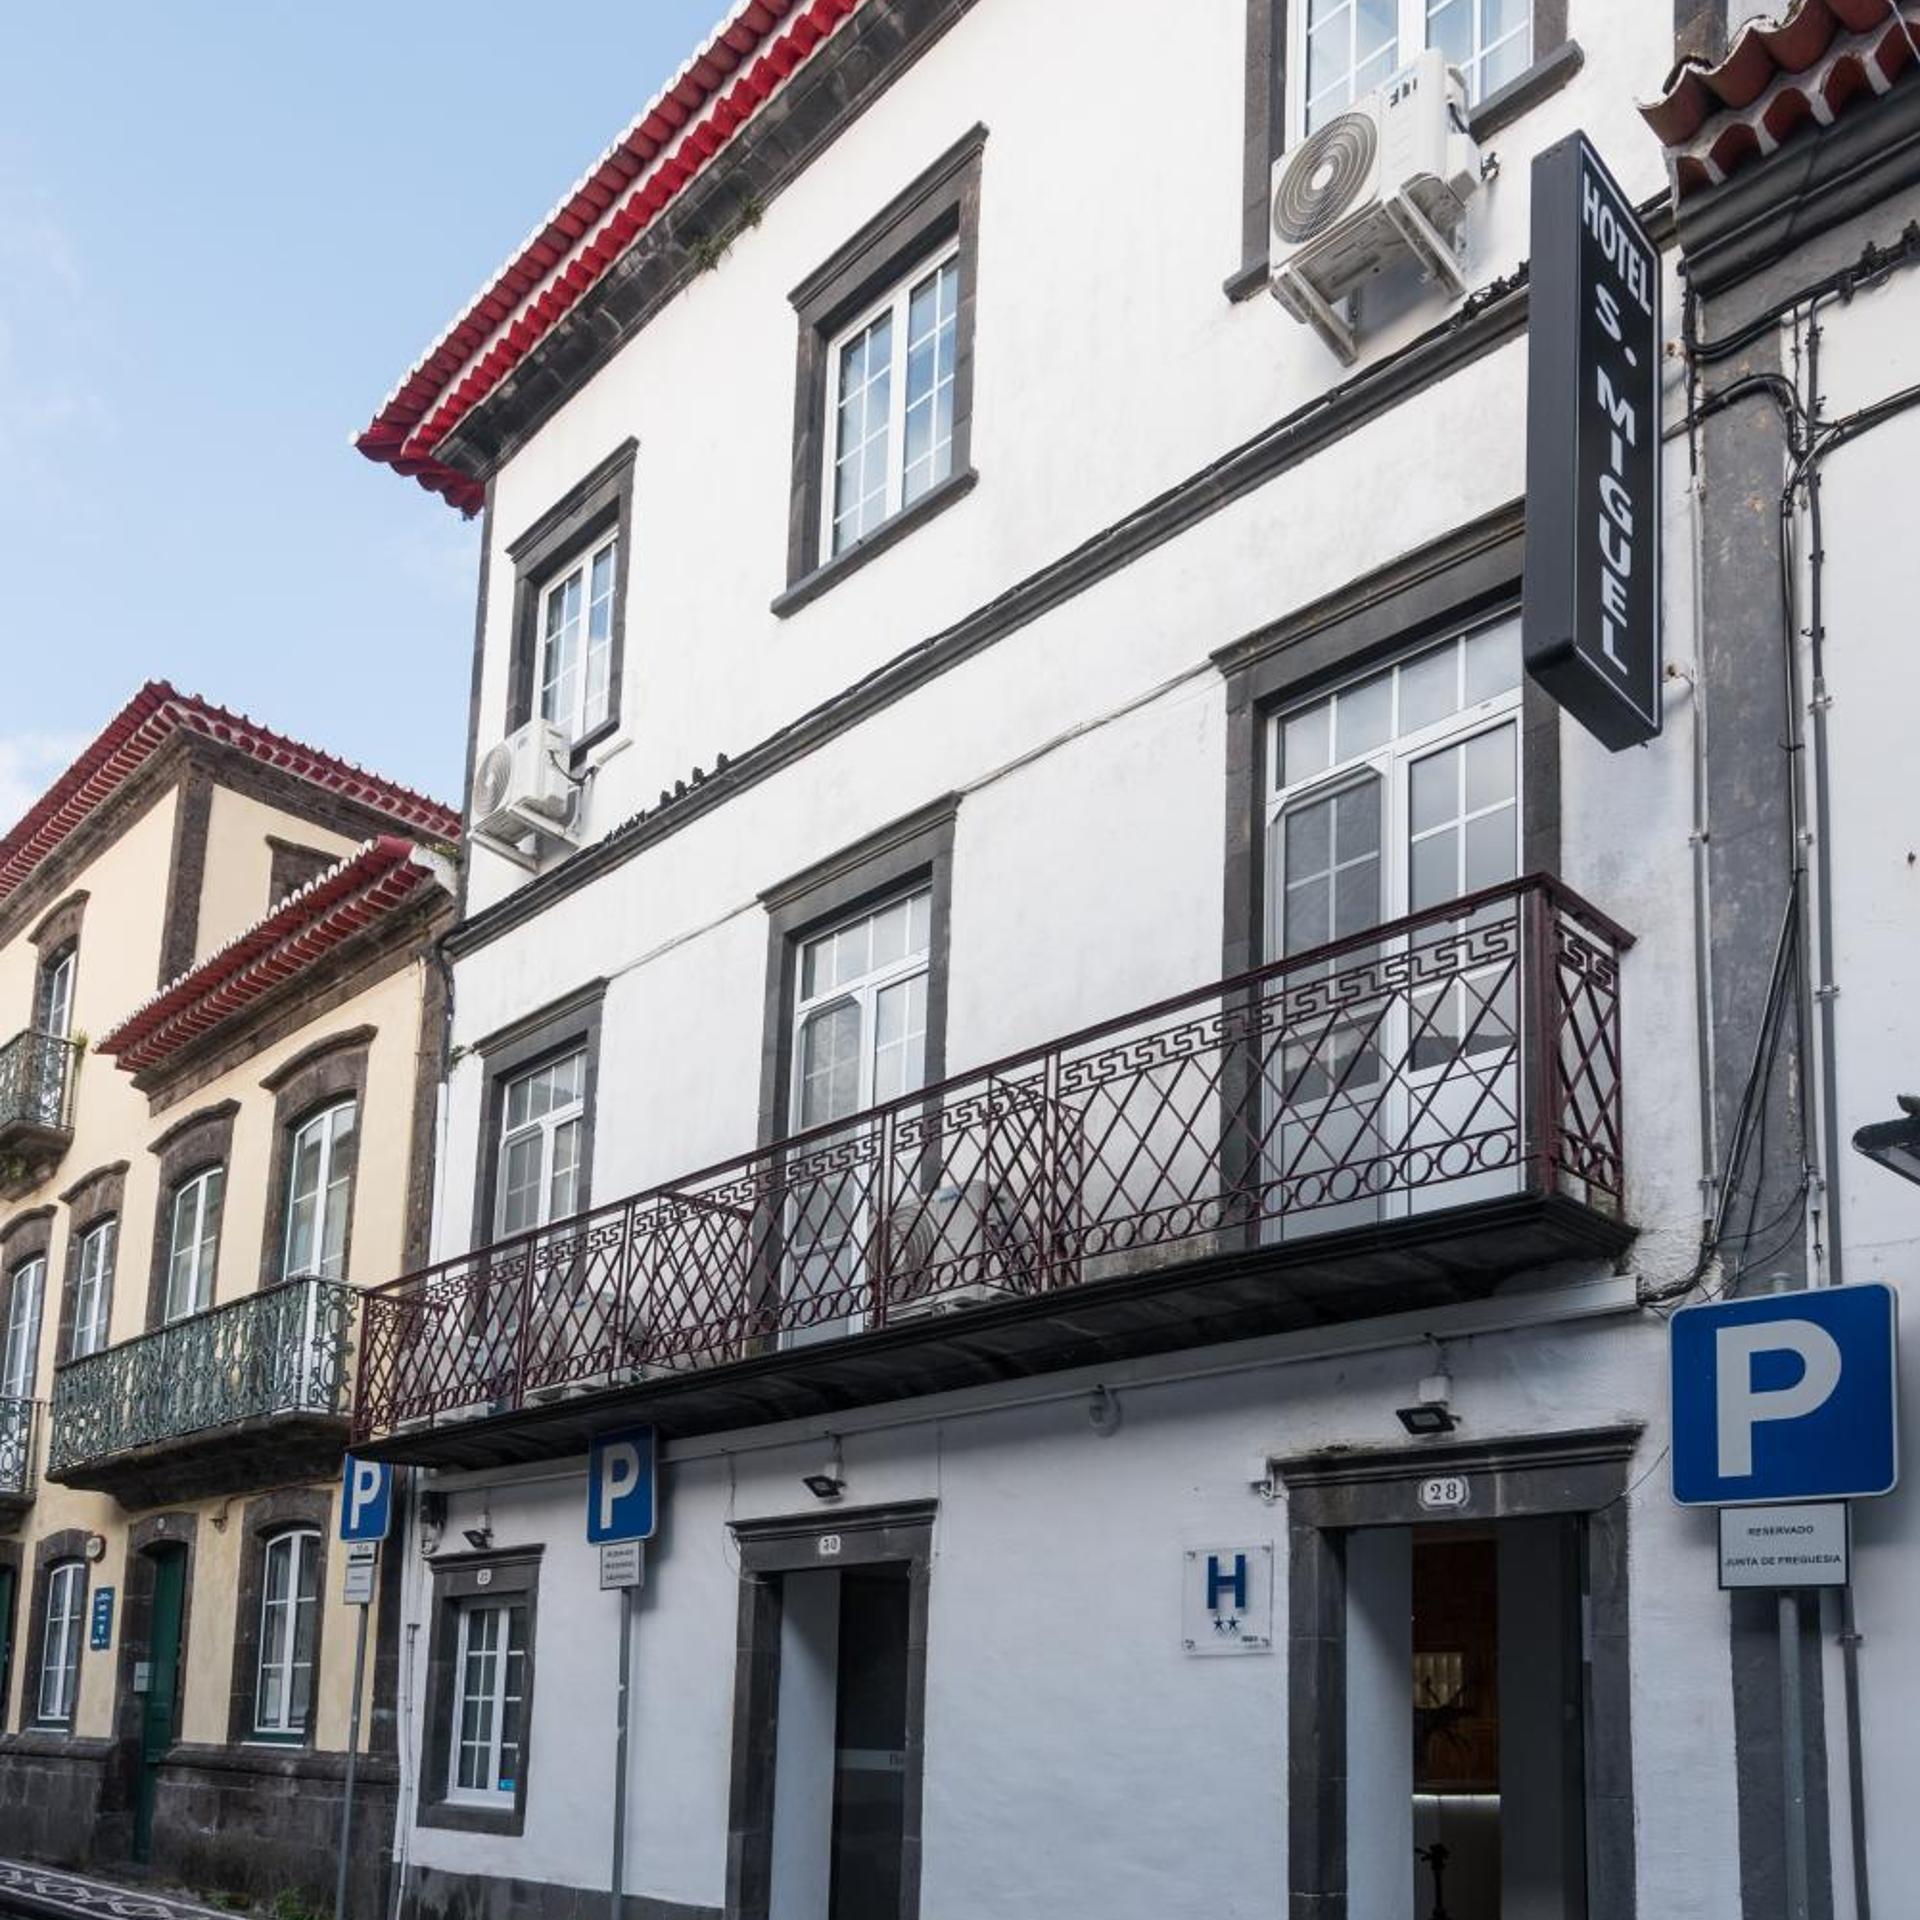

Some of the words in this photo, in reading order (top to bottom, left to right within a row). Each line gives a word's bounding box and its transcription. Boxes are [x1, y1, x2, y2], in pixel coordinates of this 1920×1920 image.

[1580, 172, 1652, 316] HOTEL
[1596, 364, 1636, 676] MIGUEL
[1716, 1318, 1842, 1479] P
[350, 1459, 382, 1530] P
[601, 1441, 640, 1530] P
[1429, 1481, 1459, 1501] 28
[1725, 1556, 1760, 1567] JUNTA
[1761, 1556, 1776, 1566] DE
[1777, 1554, 1842, 1565] FREGUESIA
[1748, 1525, 1814, 1537] RESERVADO
[1206, 1553, 1246, 1609] H
